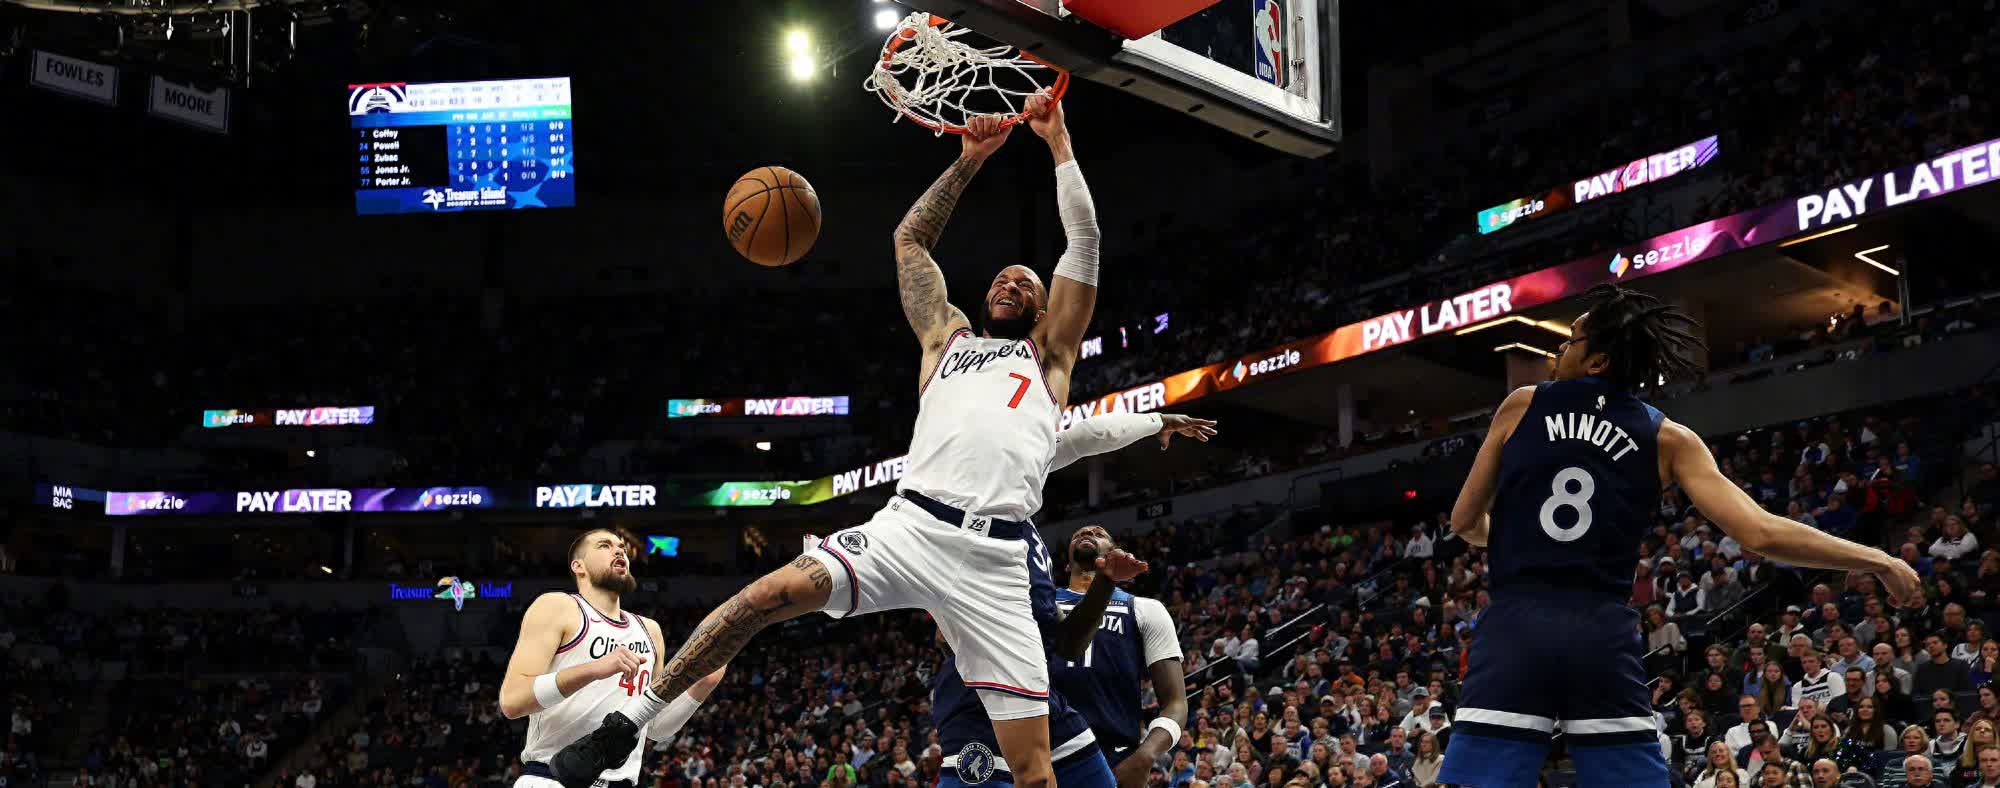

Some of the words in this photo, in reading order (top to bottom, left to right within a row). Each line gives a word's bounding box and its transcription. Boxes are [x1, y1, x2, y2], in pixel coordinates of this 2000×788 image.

[47, 58, 104, 87] FOWLES
[1259, 62, 1272, 79] NBA
[165, 88, 216, 115] MOORE
[373, 129, 398, 139] Coffey
[374, 141, 400, 151] Powell
[374, 154, 399, 162] Zubac
[375, 166, 399, 175] Jones
[400, 164, 410, 174] Jr.
[376, 177, 400, 187] Porter
[401, 176, 411, 185] Jr.
[1574, 170, 1618, 204] PAY
[445, 188, 478, 201] Treasure
[481, 186, 506, 200] Island
[1633, 234, 1706, 270] sezzle
[1797, 178, 1873, 231] PAY
[1249, 349, 1300, 376] sezzle
[1362, 310, 1414, 350] PAY
[1421, 283, 1512, 335] LATER
[941, 339, 1032, 379] Clippers
[1007, 372, 1031, 409] 7
[276, 410, 307, 425] PAY
[310, 408, 360, 424] LATER
[687, 402, 723, 415] sezzle
[745, 399, 778, 415] PAY
[781, 397, 834, 415] LATER
[1059, 401, 1096, 432] PAY
[1101, 382, 1166, 417] LATER
[1545, 412, 1639, 461] MINOTT
[53, 486, 73, 498] MIA
[833, 468, 862, 497] PAY
[53, 497, 73, 509] SAC
[140, 495, 184, 510] sezzle
[237, 491, 279, 512] PAY
[283, 490, 352, 512] LATER
[435, 490, 482, 505] sezzle
[536, 486, 586, 507] PAY
[584, 485, 656, 507] LATER
[742, 487, 791, 501] sezzle
[1540, 467, 1595, 541] 8
[389, 582, 432, 600] Treasure
[480, 580, 512, 599] Island
